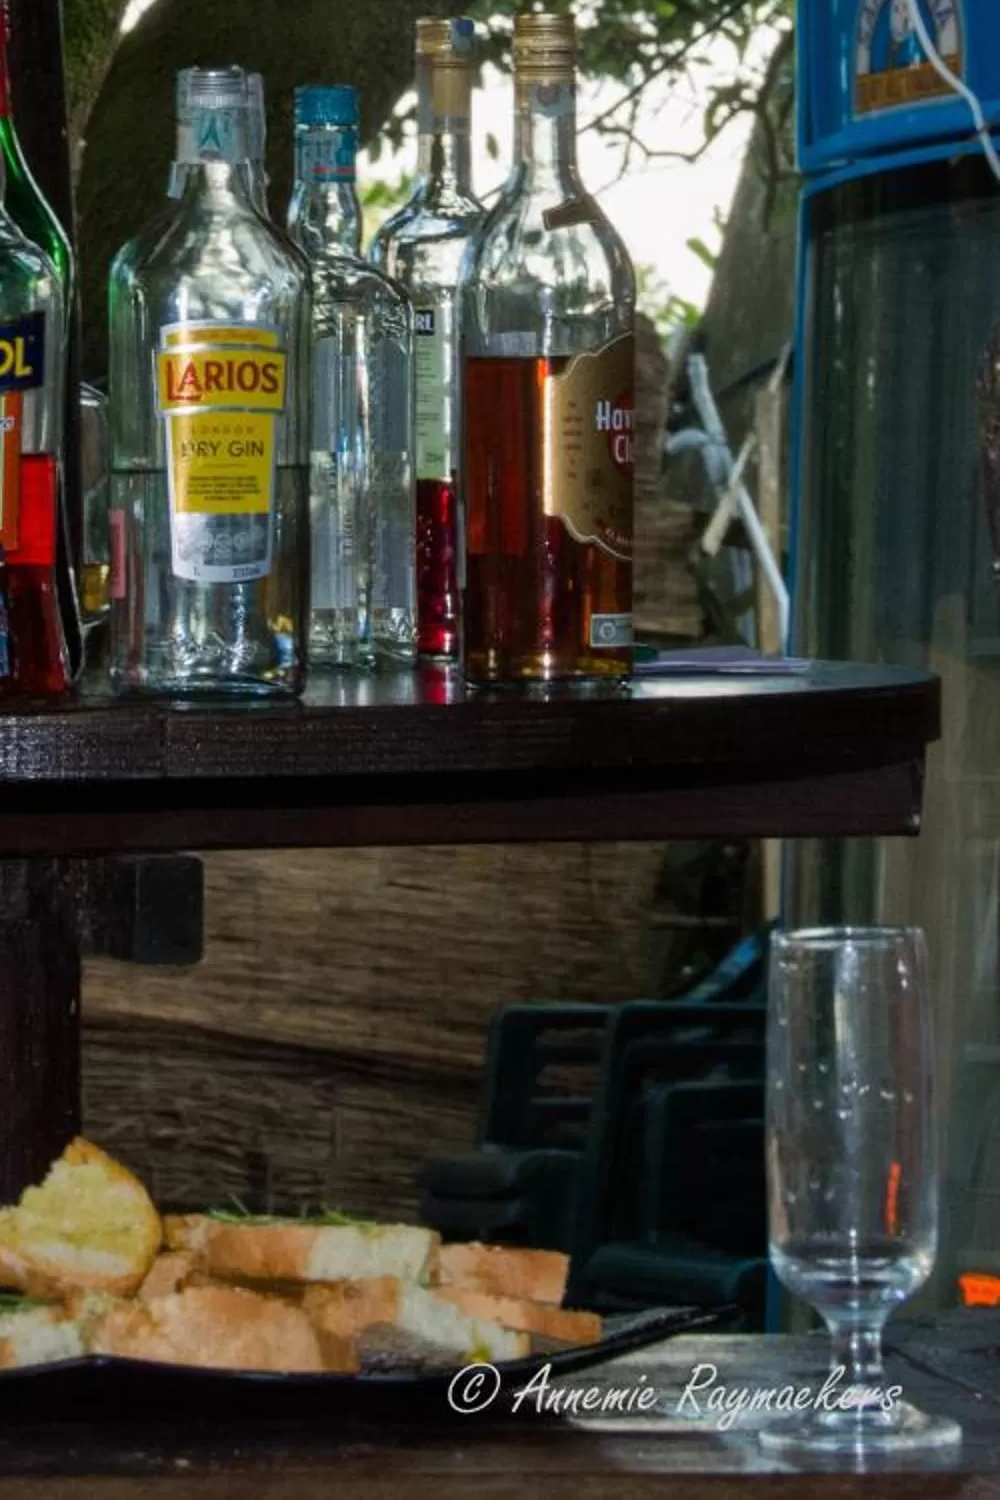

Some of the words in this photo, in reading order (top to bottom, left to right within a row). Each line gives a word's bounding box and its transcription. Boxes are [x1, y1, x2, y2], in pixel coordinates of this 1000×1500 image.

[165, 360, 280, 403] LARIOS
[181, 440, 221, 458] DRY
[228, 440, 265, 458] GIN
